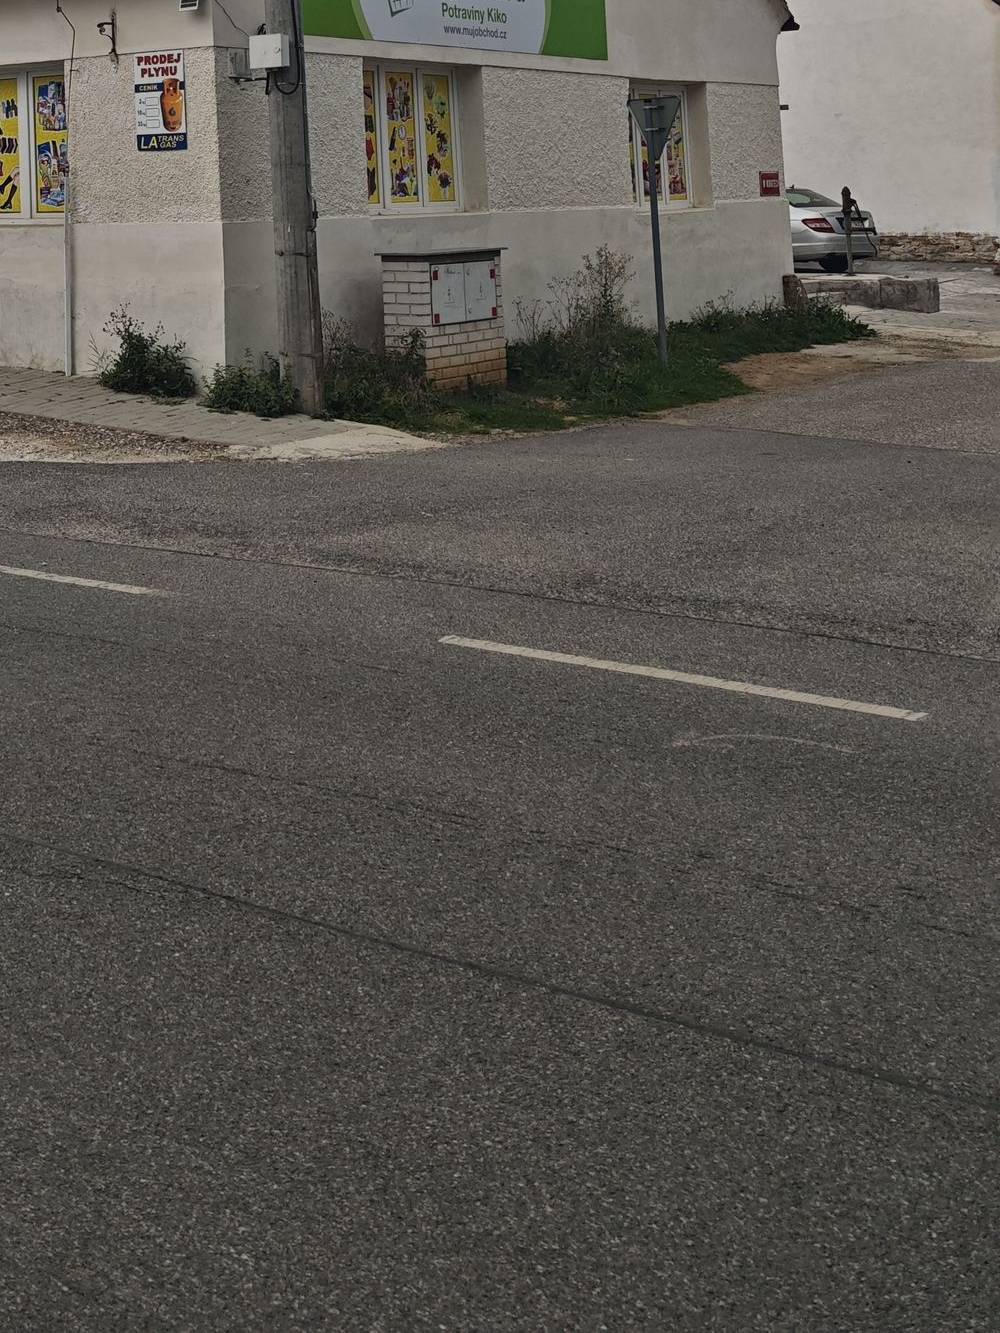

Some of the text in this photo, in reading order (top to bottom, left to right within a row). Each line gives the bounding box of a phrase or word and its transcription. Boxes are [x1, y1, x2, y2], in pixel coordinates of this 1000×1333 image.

[441, 2, 507, 24] Potraviny Kiko
[443, 25, 507, 39] www.mujobchod.cz
[136, 53, 182, 66] PRODEJ
[141, 66, 177, 78] PLYNU
[141, 134, 184, 149] LA TRANS
